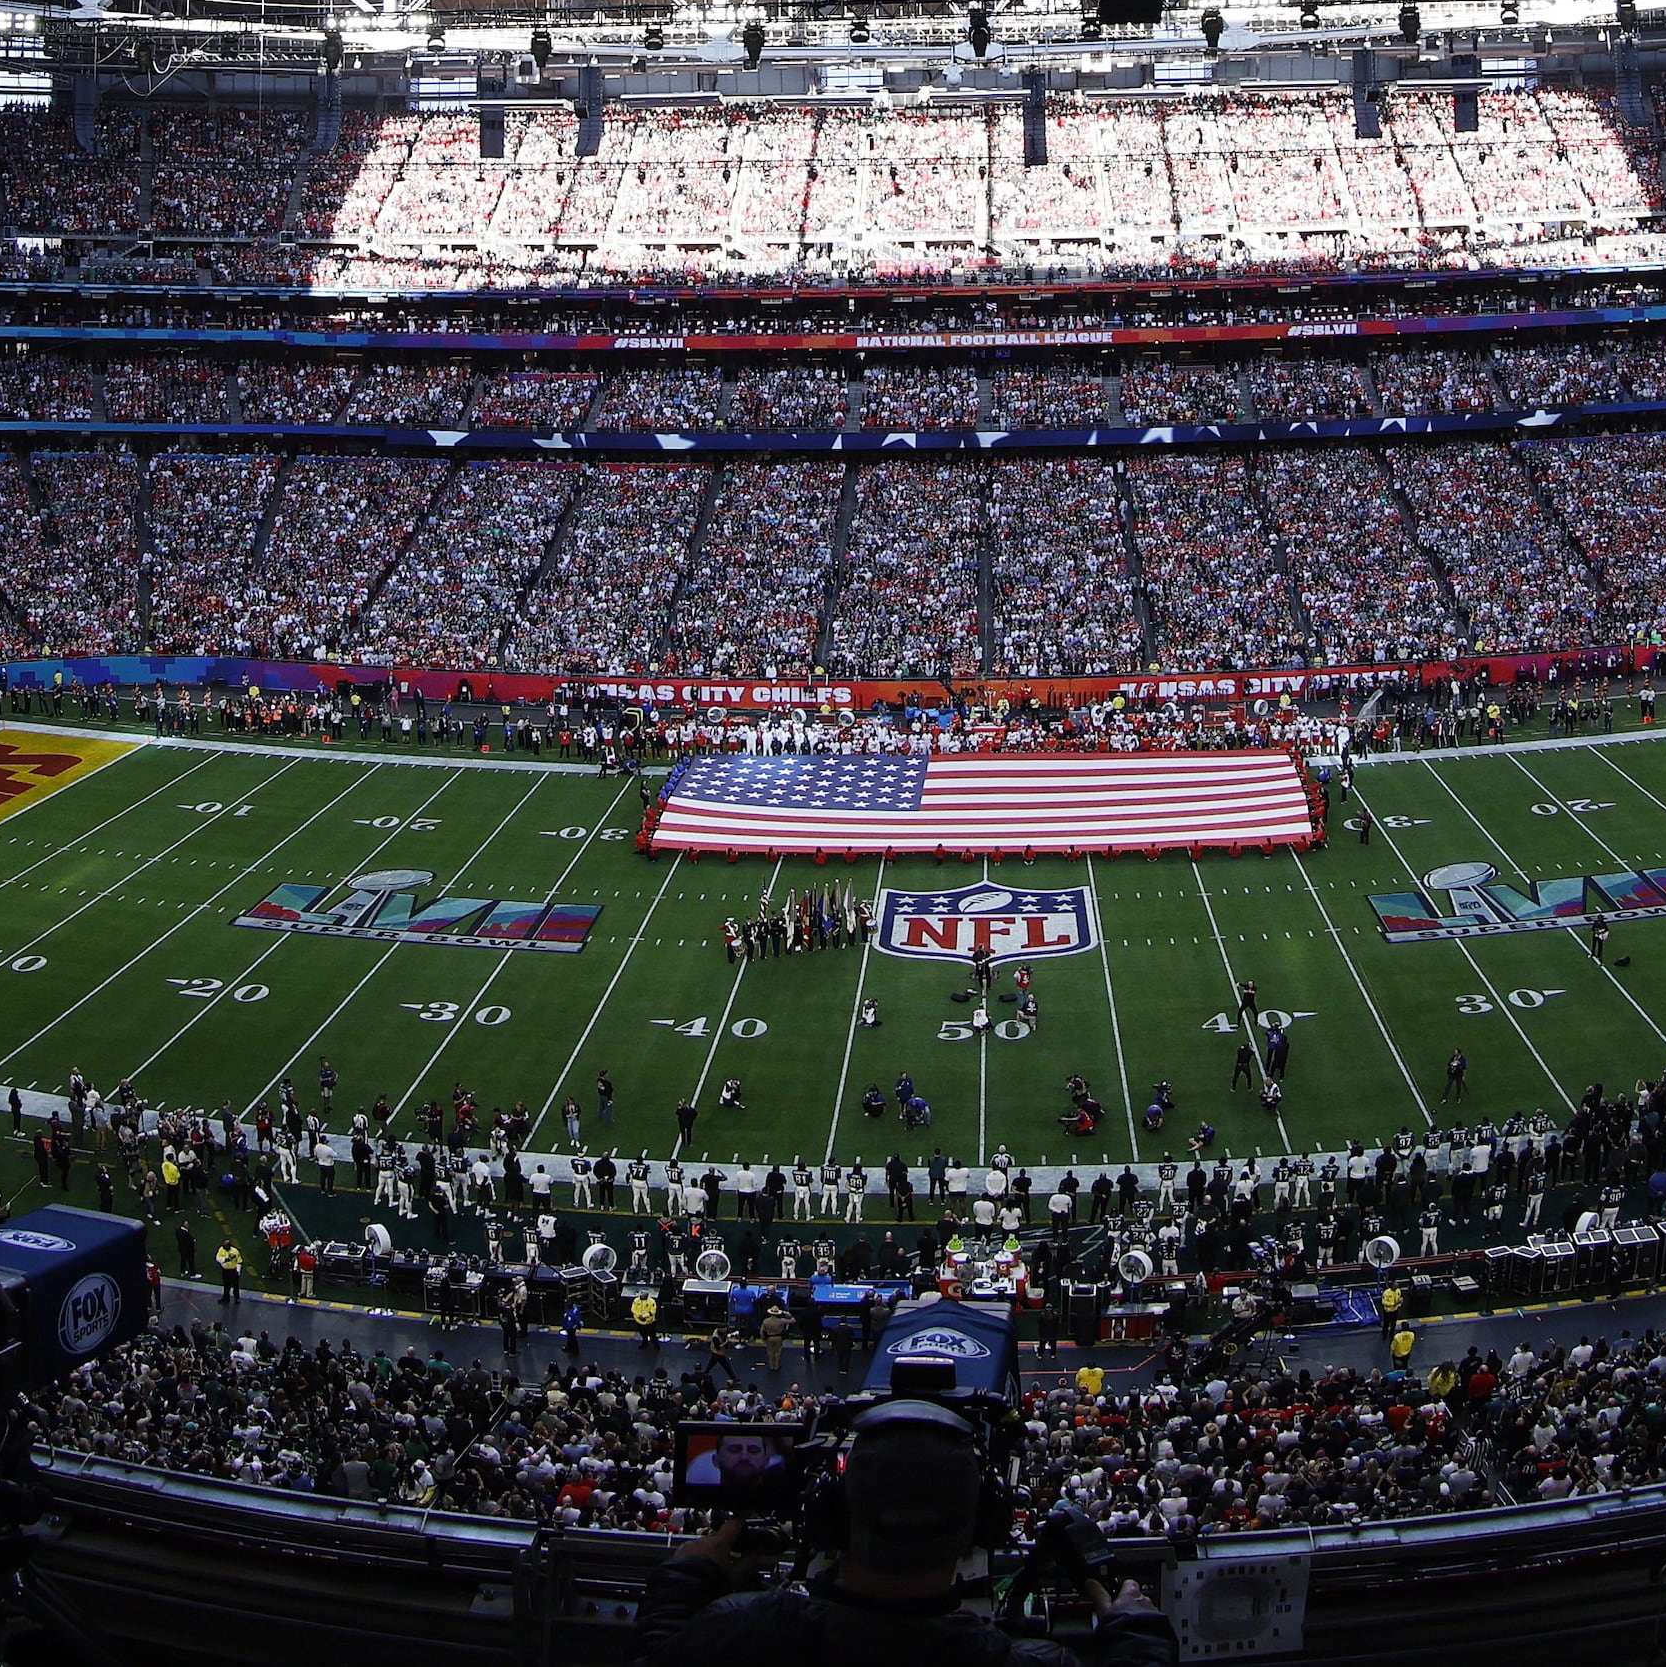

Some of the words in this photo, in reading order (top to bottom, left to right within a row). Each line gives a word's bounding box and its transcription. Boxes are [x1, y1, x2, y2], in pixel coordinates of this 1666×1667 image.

[855, 334, 944, 349] NATIONAL
[951, 332, 1038, 348] FOOTBALL
[1044, 331, 1114, 346] LEAGUE
[1287, 322, 1358, 337] #SBLVII
[614, 336, 685, 350] #SBLVII
[681, 686, 746, 703] CITY
[247, 881, 605, 944] LVII
[260, 919, 401, 940] SUPER
[424, 934, 549, 950] BOWL
[899, 913, 1072, 954] NFL
[1417, 918, 1560, 940] SUPER
[178, 976, 271, 1005] 20
[1454, 986, 1547, 1015] 30
[418, 1000, 512, 1027] 30
[1201, 1009, 1294, 1034] 40
[672, 1015, 769, 1039] 40
[936, 1019, 1033, 1042] 50
[70, 1283, 110, 1331] FOX
[73, 1312, 110, 1345] SPORTS
[910, 1332, 967, 1348] FOX
